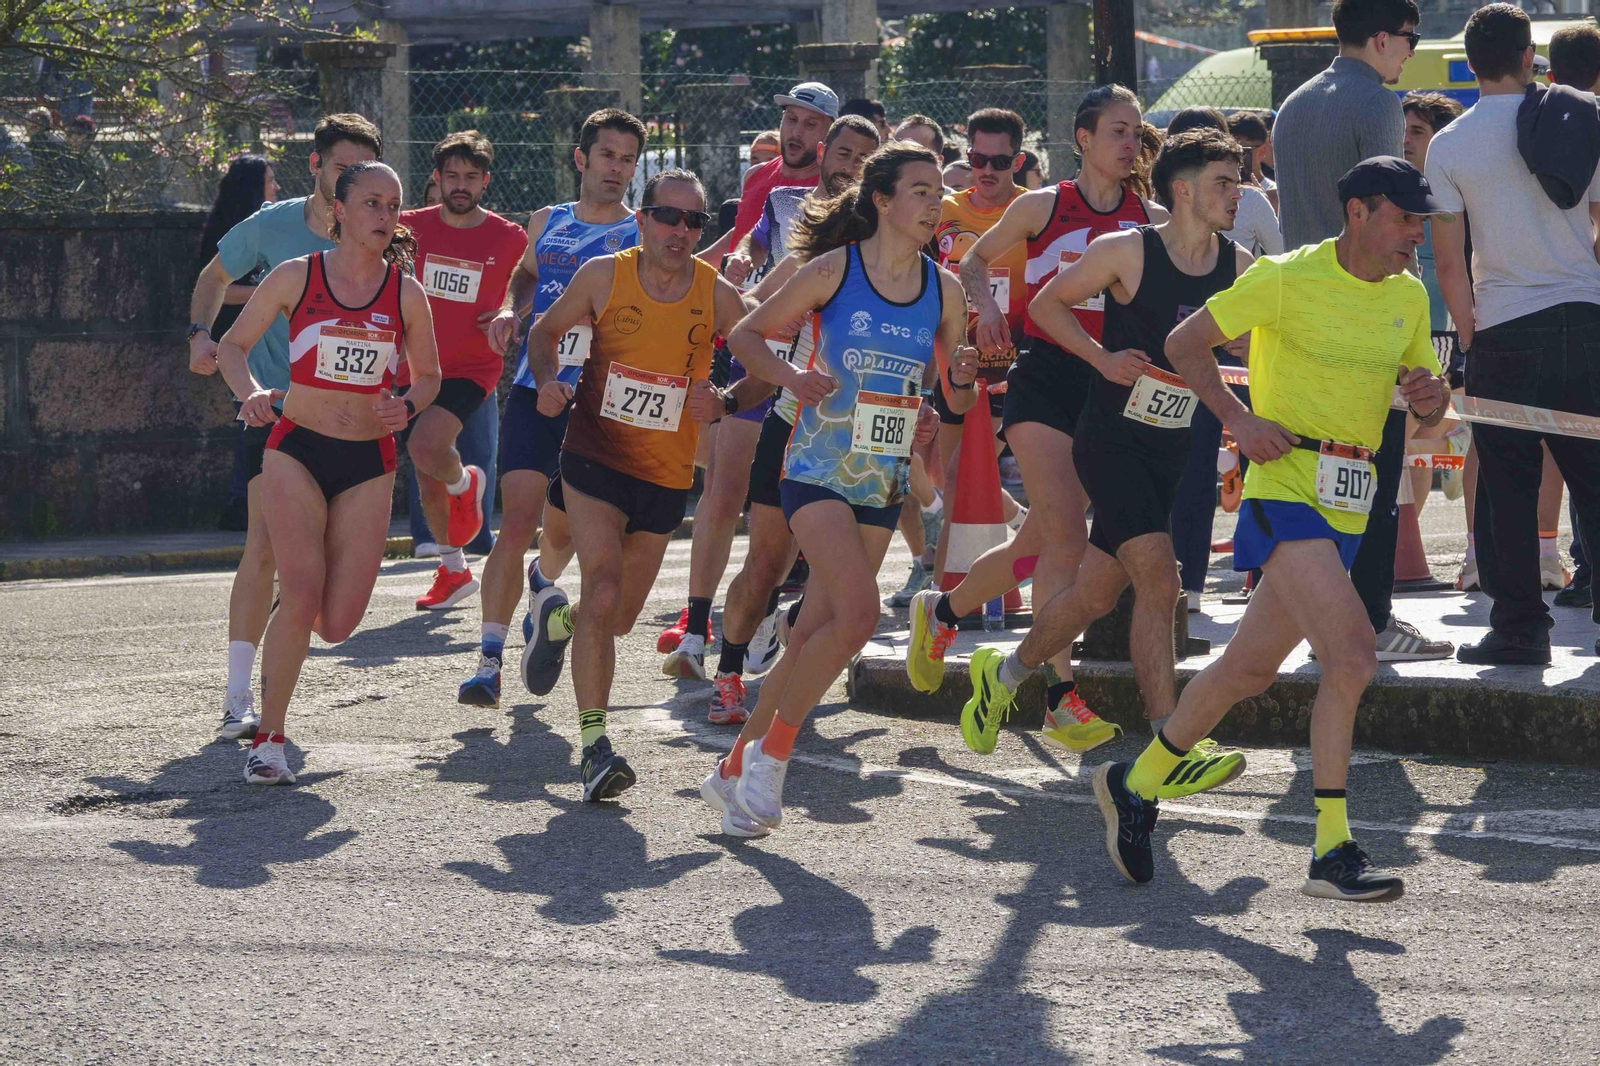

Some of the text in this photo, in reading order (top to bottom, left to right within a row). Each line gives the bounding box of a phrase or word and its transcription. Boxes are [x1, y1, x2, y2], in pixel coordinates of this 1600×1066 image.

[545, 236, 577, 246] DISMAC
[433, 270, 470, 295] 1056
[334, 345, 378, 375] 332
[620, 386, 666, 419] 273
[1146, 389, 1191, 419] 520
[870, 414, 906, 445] 688
[1334, 467, 1372, 501] 907
